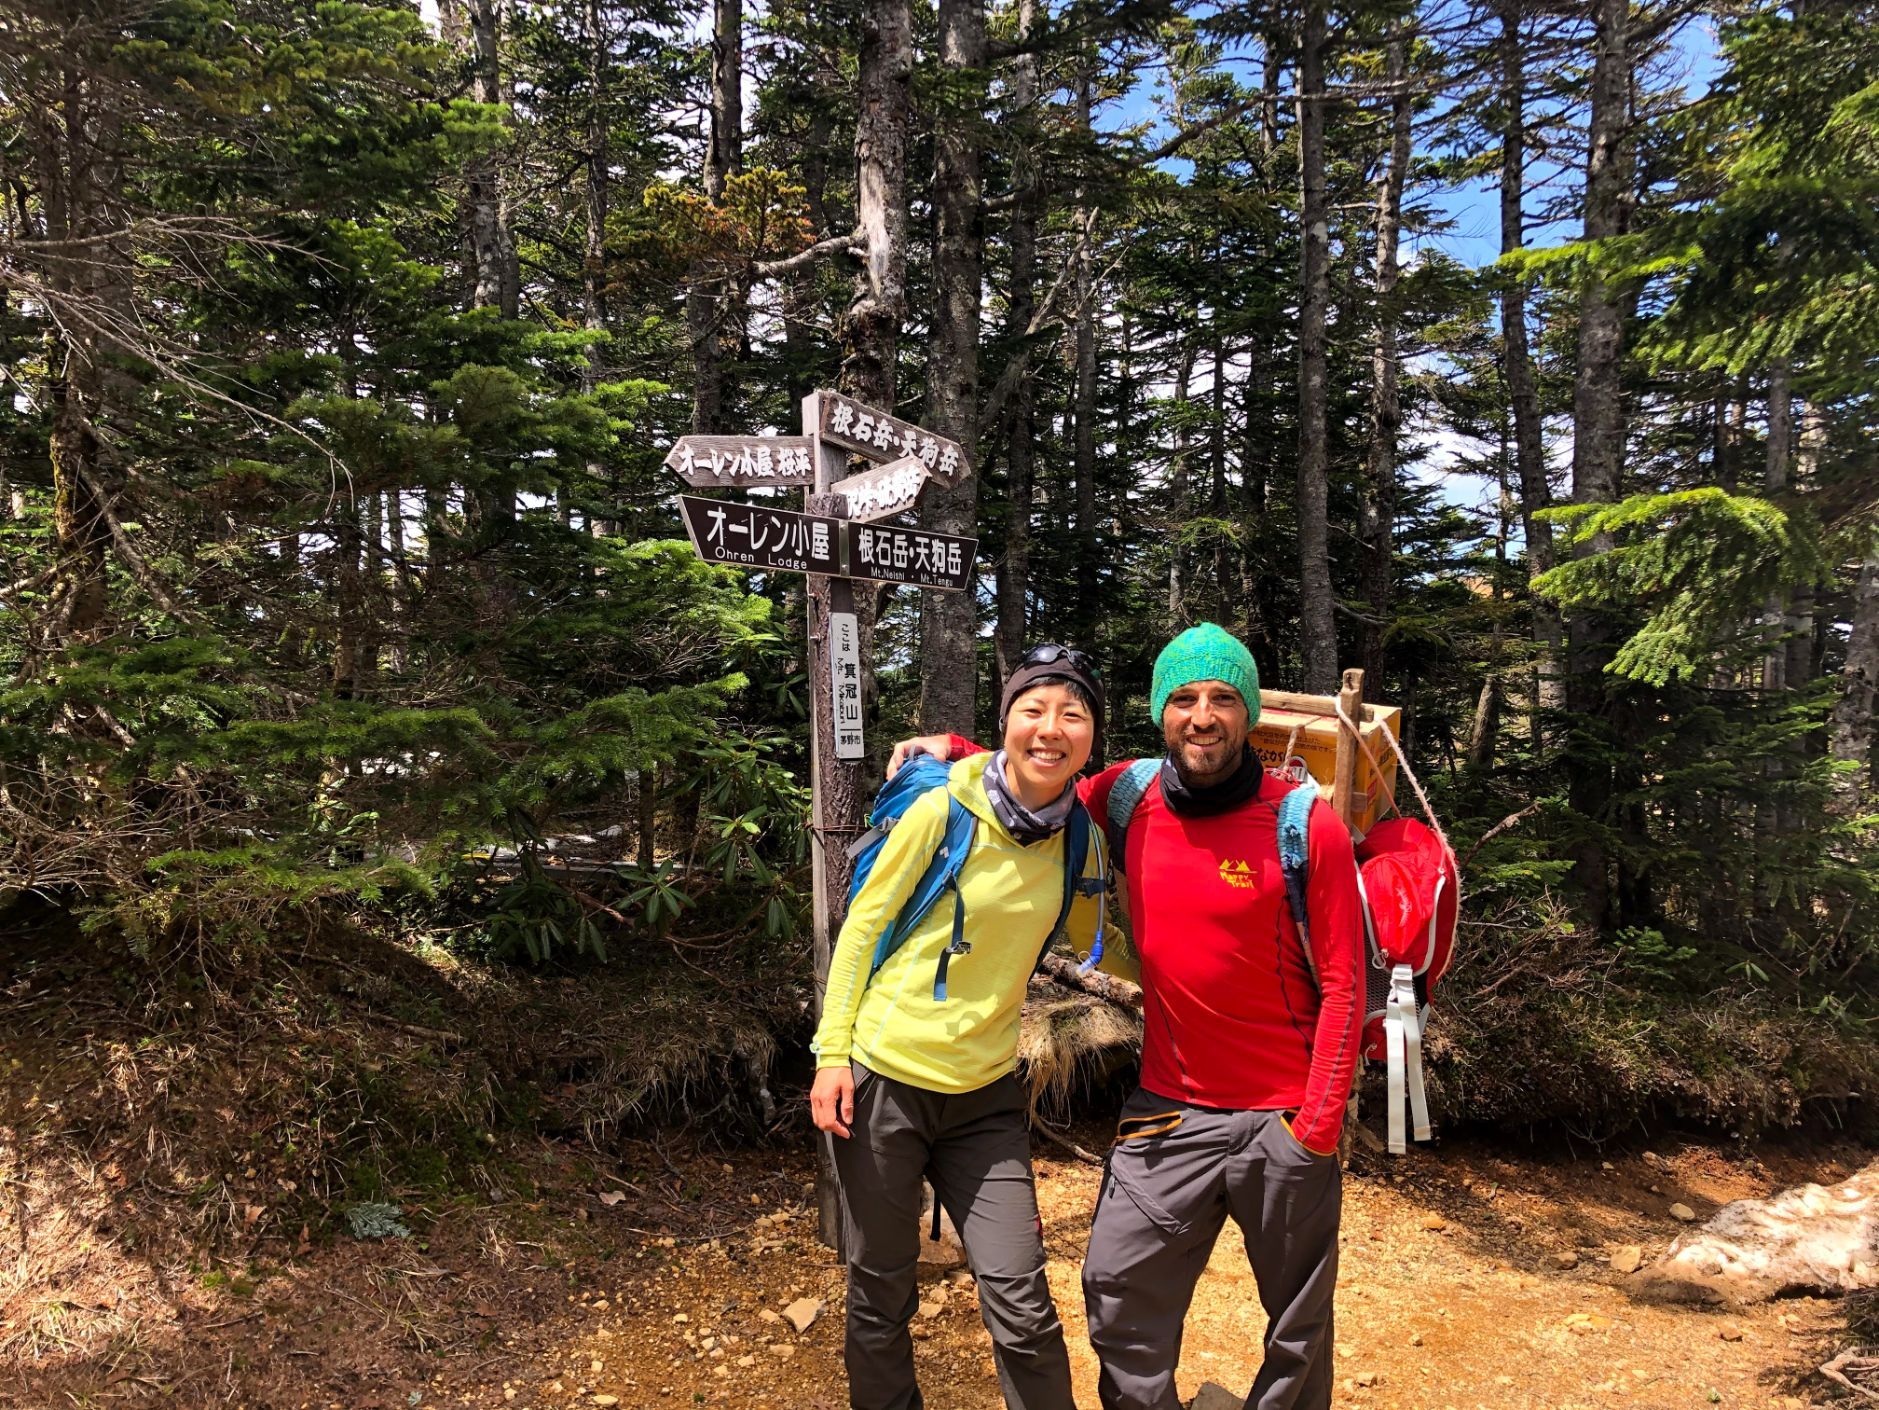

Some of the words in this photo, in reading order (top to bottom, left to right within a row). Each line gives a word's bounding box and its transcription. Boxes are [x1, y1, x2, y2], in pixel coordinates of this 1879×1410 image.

[678, 443, 776, 477] オーレン小屋
[707, 503, 830, 561] オーレン小屋
[858, 527, 962, 576] 根石岳・天狗岳
[714, 545, 755, 563] Ohren
[767, 552, 808, 570] Lodge
[841, 623, 851, 652] ここは
[844, 662, 858, 720] 箕冠山
